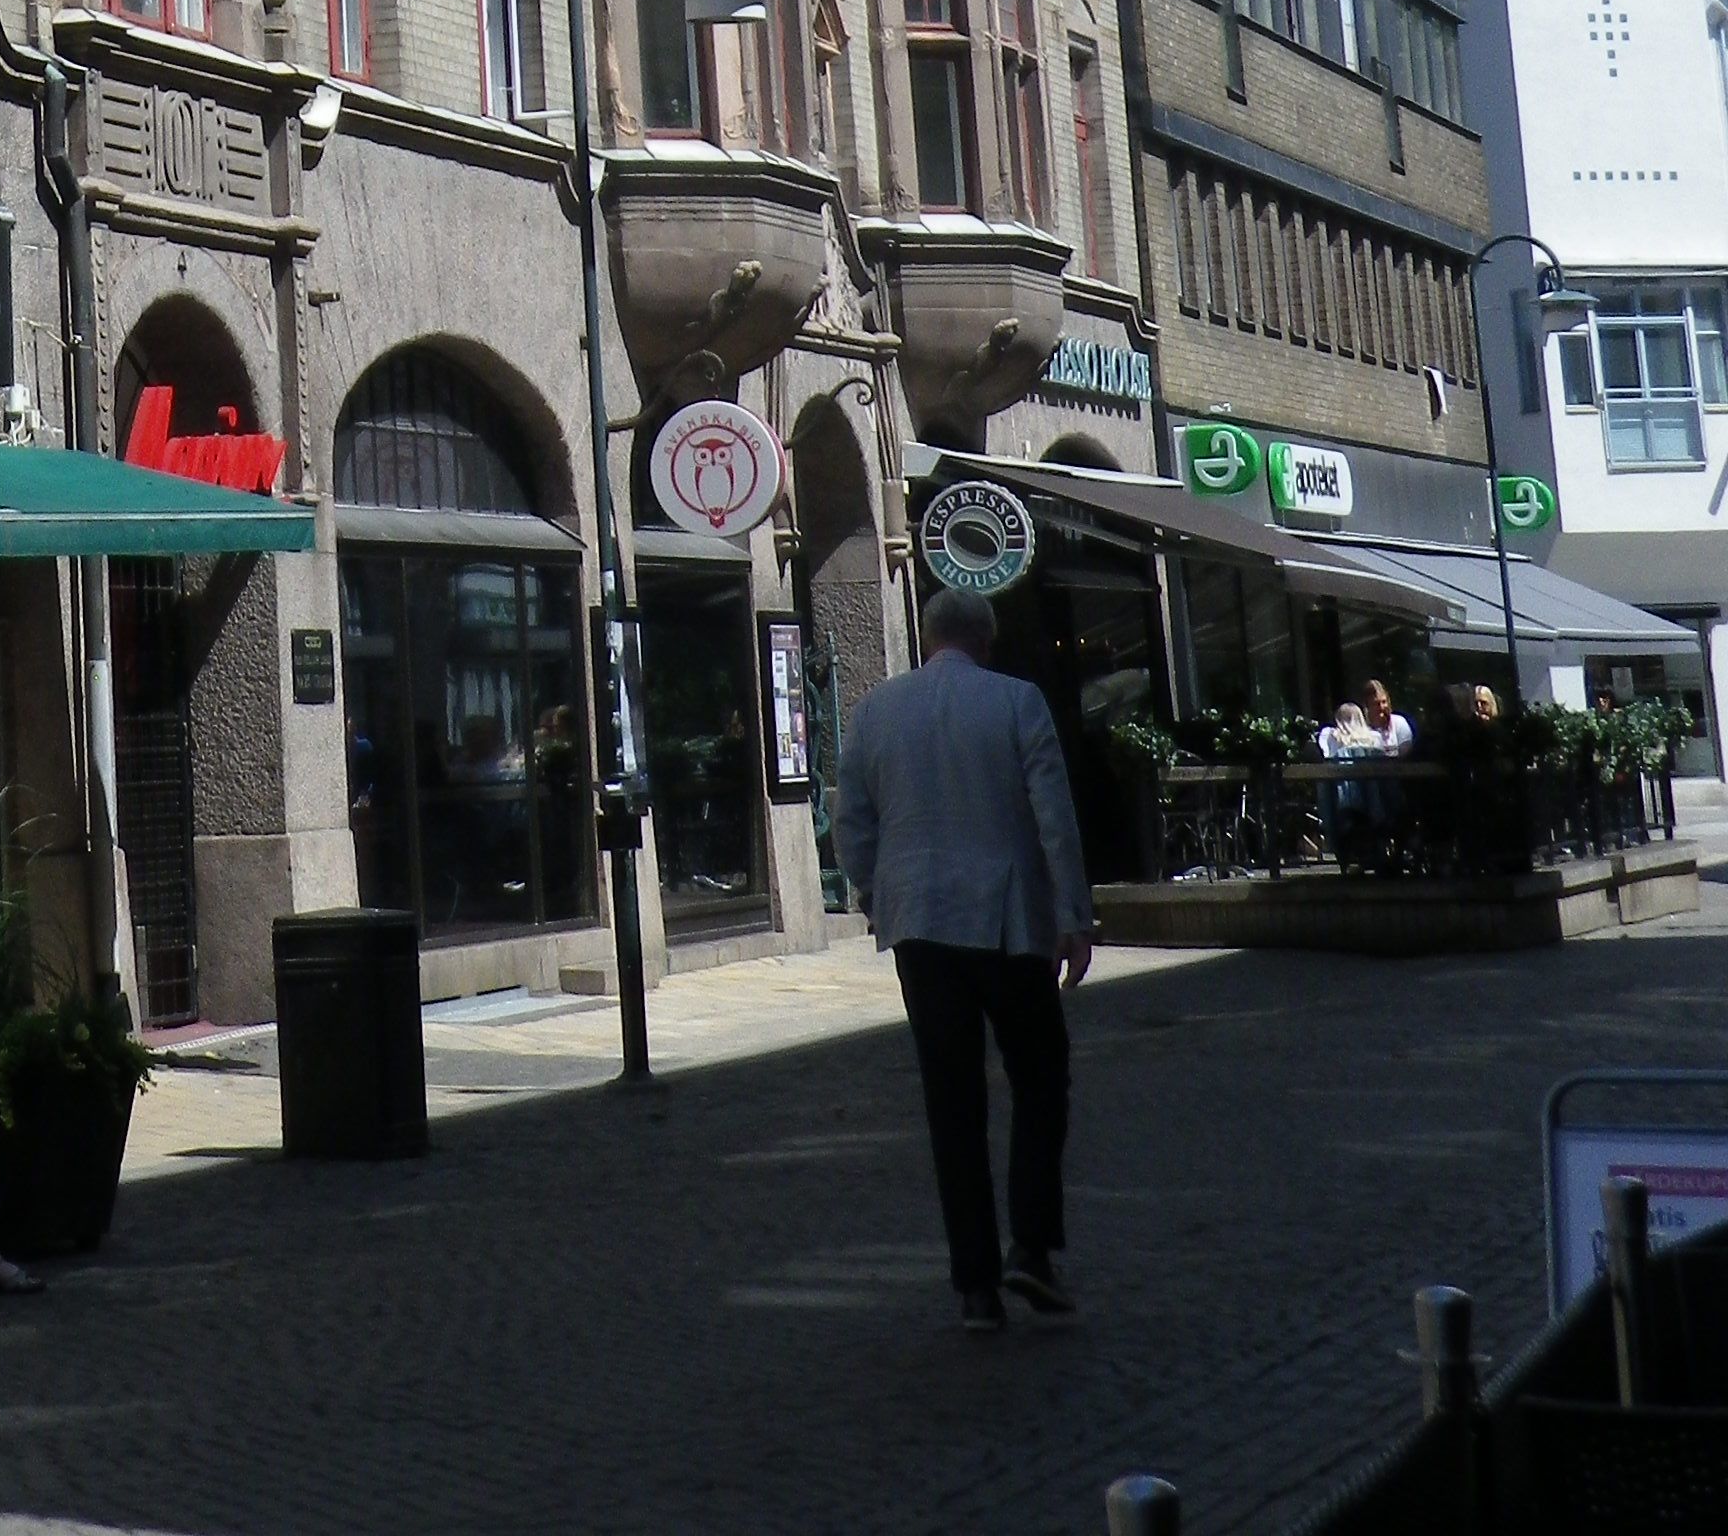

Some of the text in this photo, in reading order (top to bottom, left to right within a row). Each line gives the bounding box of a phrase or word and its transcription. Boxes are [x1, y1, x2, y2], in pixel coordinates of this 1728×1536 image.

[1099, 344, 1152, 402] HOUSE
[664, 413, 761, 456] SVENSKA BIO
[929, 489, 1020, 530] ESPRESSO
[941, 560, 1013, 588] HOUSE
